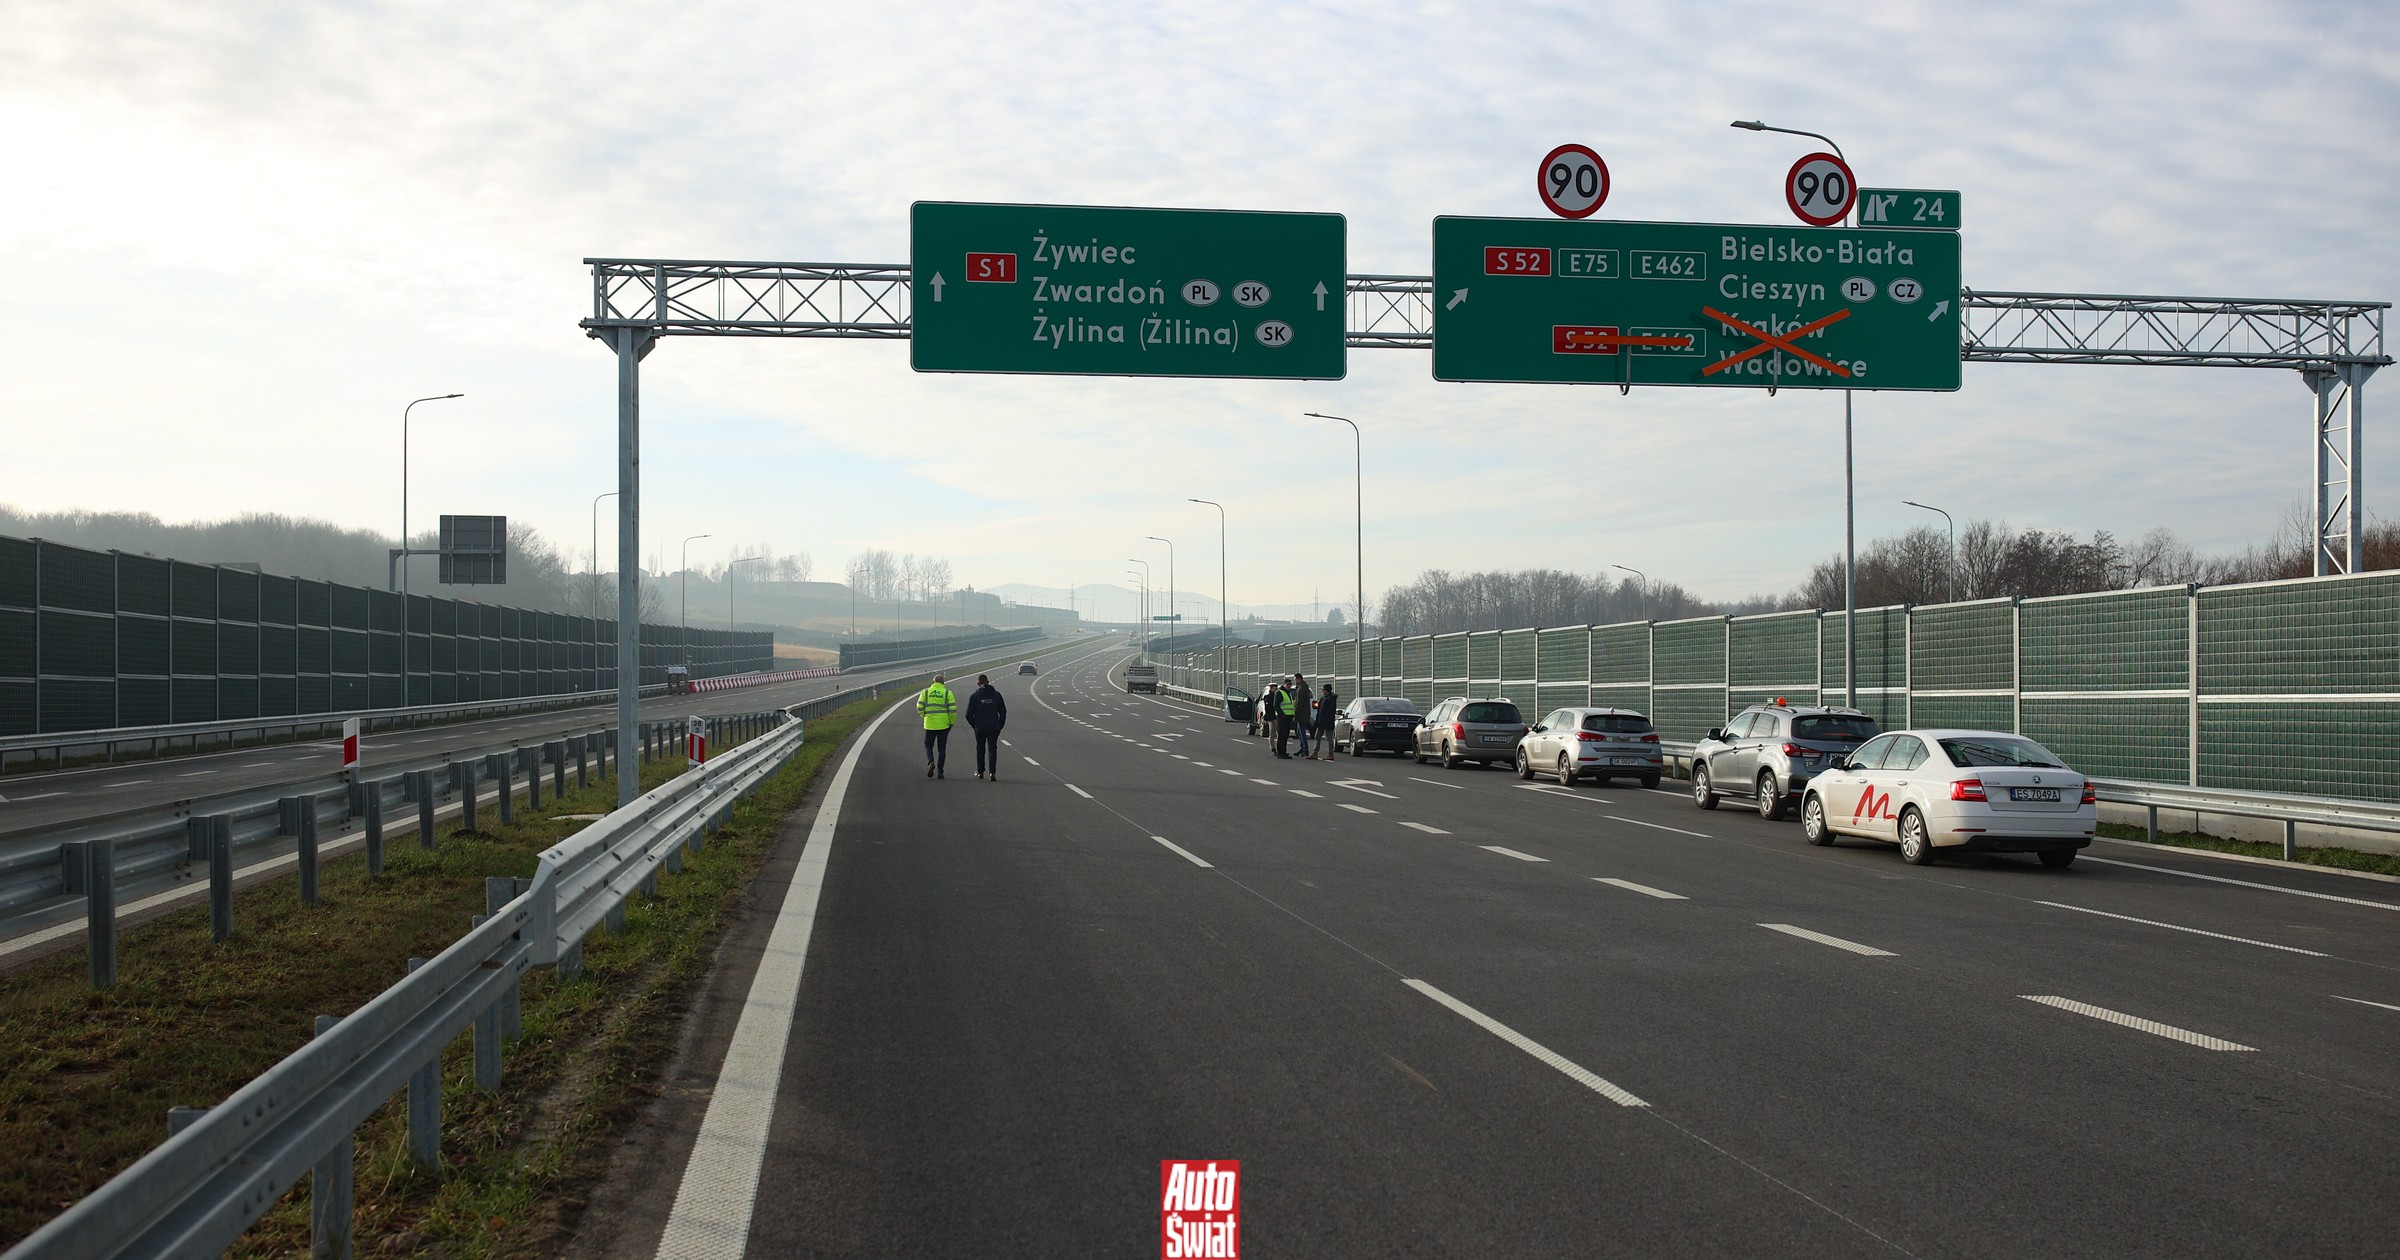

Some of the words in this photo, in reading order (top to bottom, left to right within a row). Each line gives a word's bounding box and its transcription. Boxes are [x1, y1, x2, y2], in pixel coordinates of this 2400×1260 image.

[1550, 164, 1598, 199] 90
[1798, 172, 1845, 206] 90
[1913, 198, 1945, 222] 24
[1032, 229, 1137, 270] Żywiec
[1721, 236, 1915, 266] Bielsko-Biała
[1033, 276, 1166, 306] Zwardoń
[1192, 285, 1211, 302] PL
[1241, 286, 1264, 303] SK
[1719, 274, 1825, 308] Cieszyn
[1850, 283, 1867, 297] PL
[1894, 284, 1915, 298] CZ
[1032, 309, 1126, 349] Żylina
[1139, 312, 1240, 353] (Žilina)
[1264, 326, 1288, 342] SK
[2017, 789, 2028, 799] ES
[2032, 789, 2057, 799] 7049A
